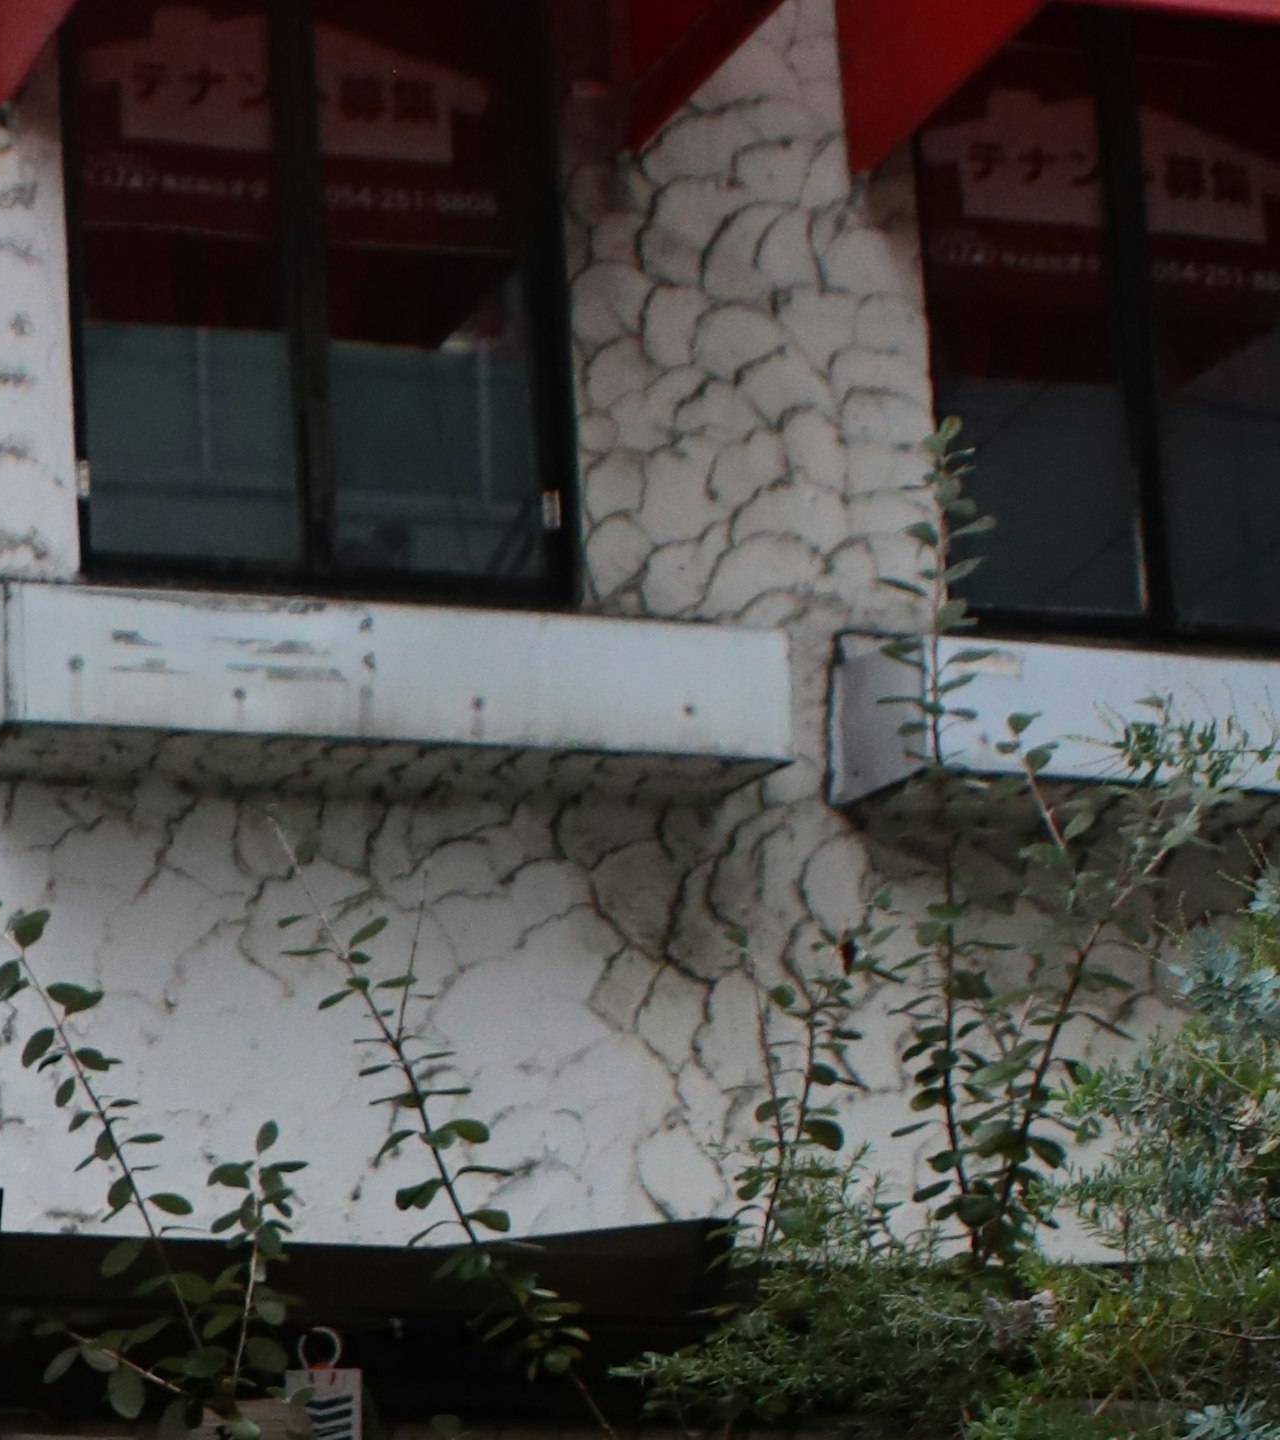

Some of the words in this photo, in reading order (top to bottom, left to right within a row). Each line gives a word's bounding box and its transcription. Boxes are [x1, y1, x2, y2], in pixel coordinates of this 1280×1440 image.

[132, 61, 437, 123] テナン募集
